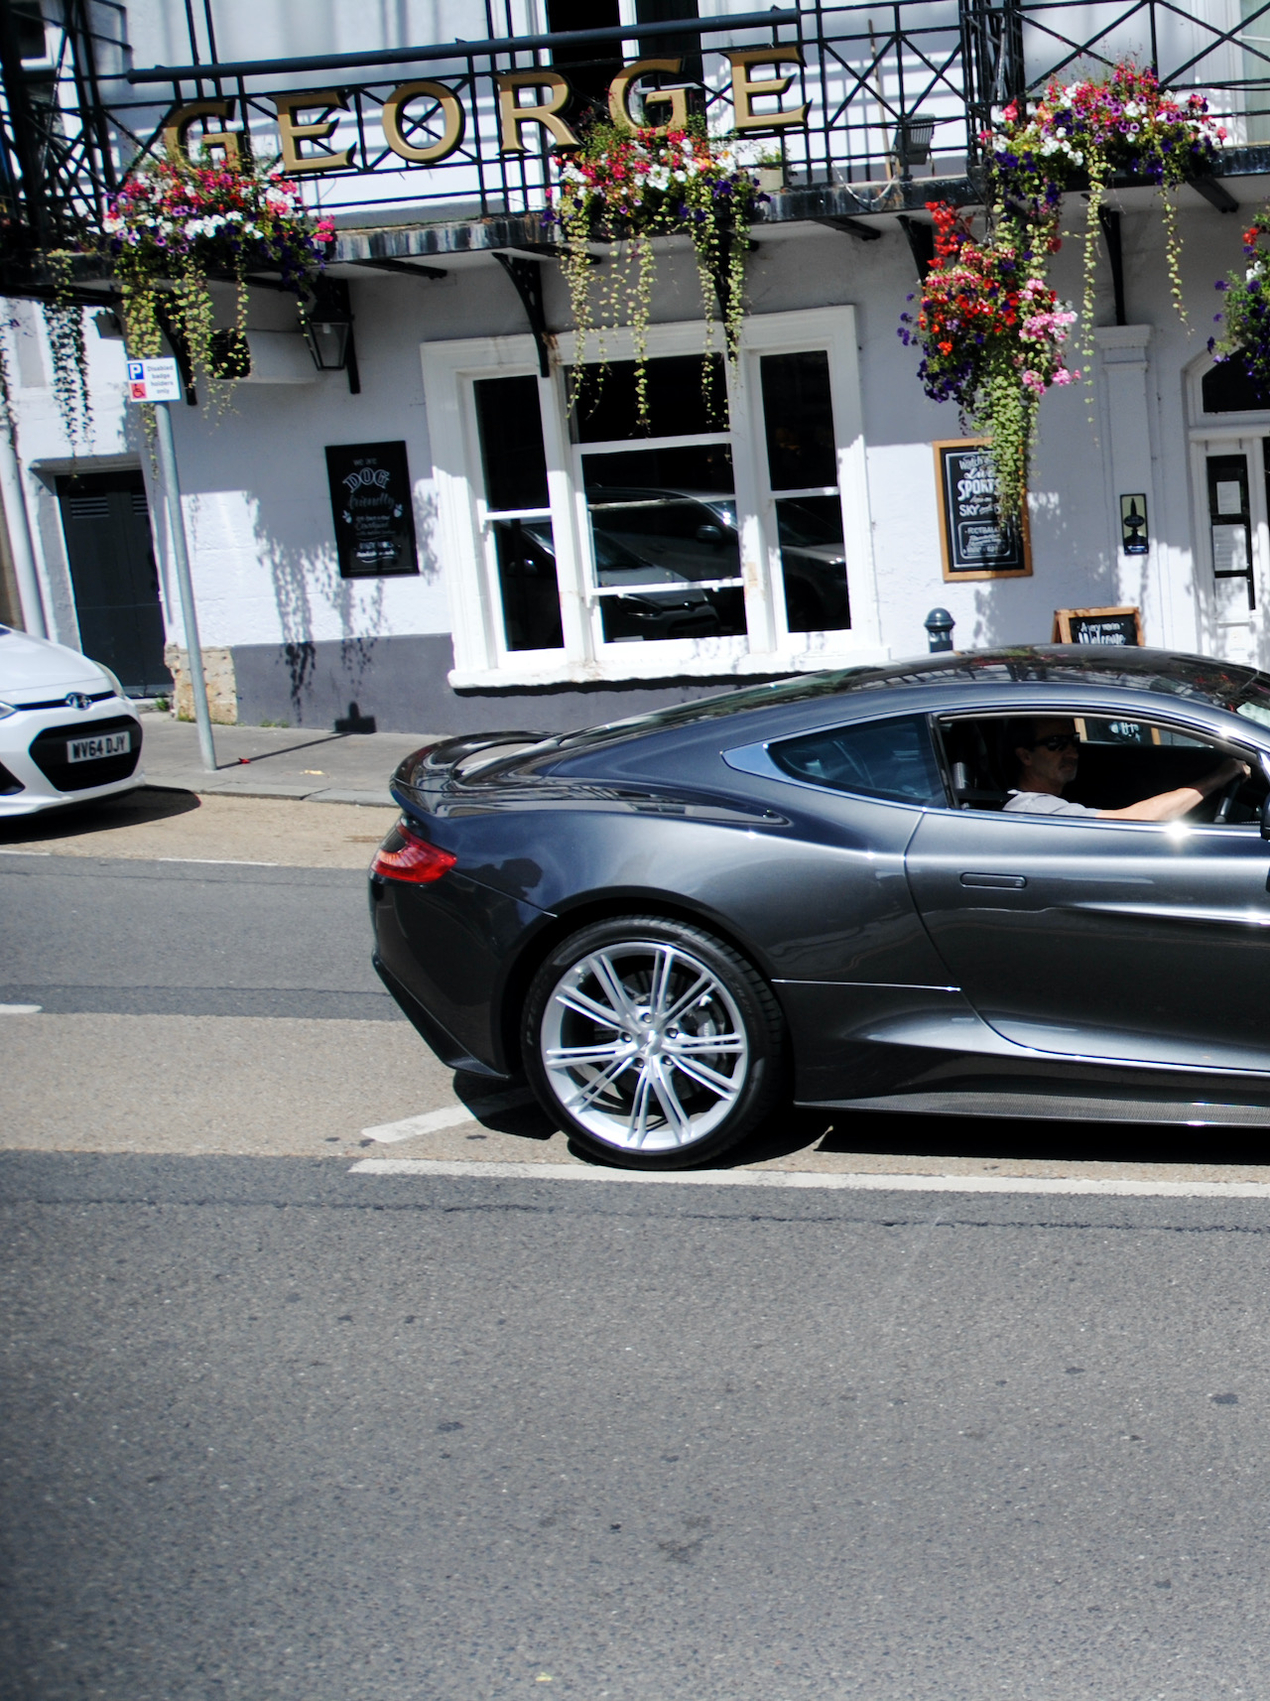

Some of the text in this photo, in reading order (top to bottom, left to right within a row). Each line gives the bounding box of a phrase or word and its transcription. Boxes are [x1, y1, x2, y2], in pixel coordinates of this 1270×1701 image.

[162, 47, 812, 175] GEORGE
[129, 364, 142, 380] P
[342, 467, 390, 493] DOG
[959, 504, 980, 517] SKY
[72, 735, 126, 759] WV64 DJY
